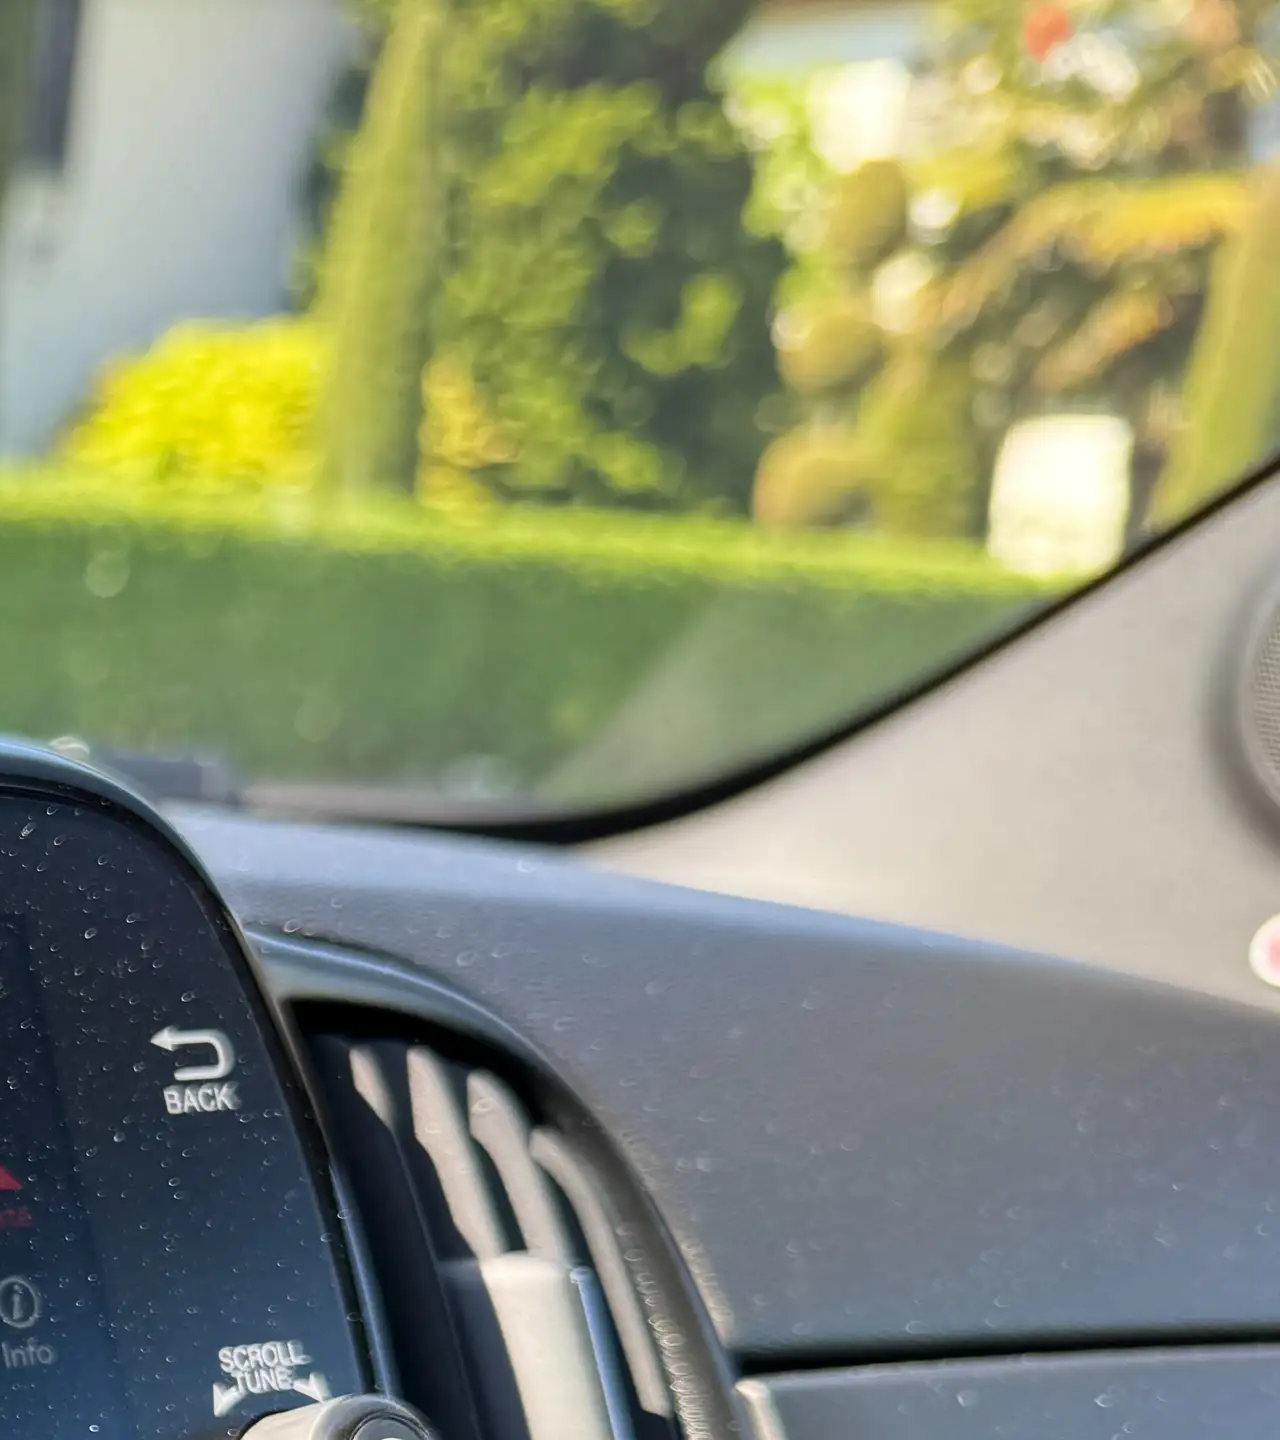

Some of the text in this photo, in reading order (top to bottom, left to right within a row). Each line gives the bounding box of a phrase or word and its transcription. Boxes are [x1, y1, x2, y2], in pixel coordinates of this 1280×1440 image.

[163, 1080, 240, 1115] BACK
[2, 1340, 57, 1369] Info
[218, 1340, 311, 1373] SCROLL
[232, 1368, 294, 1395] TUNE
